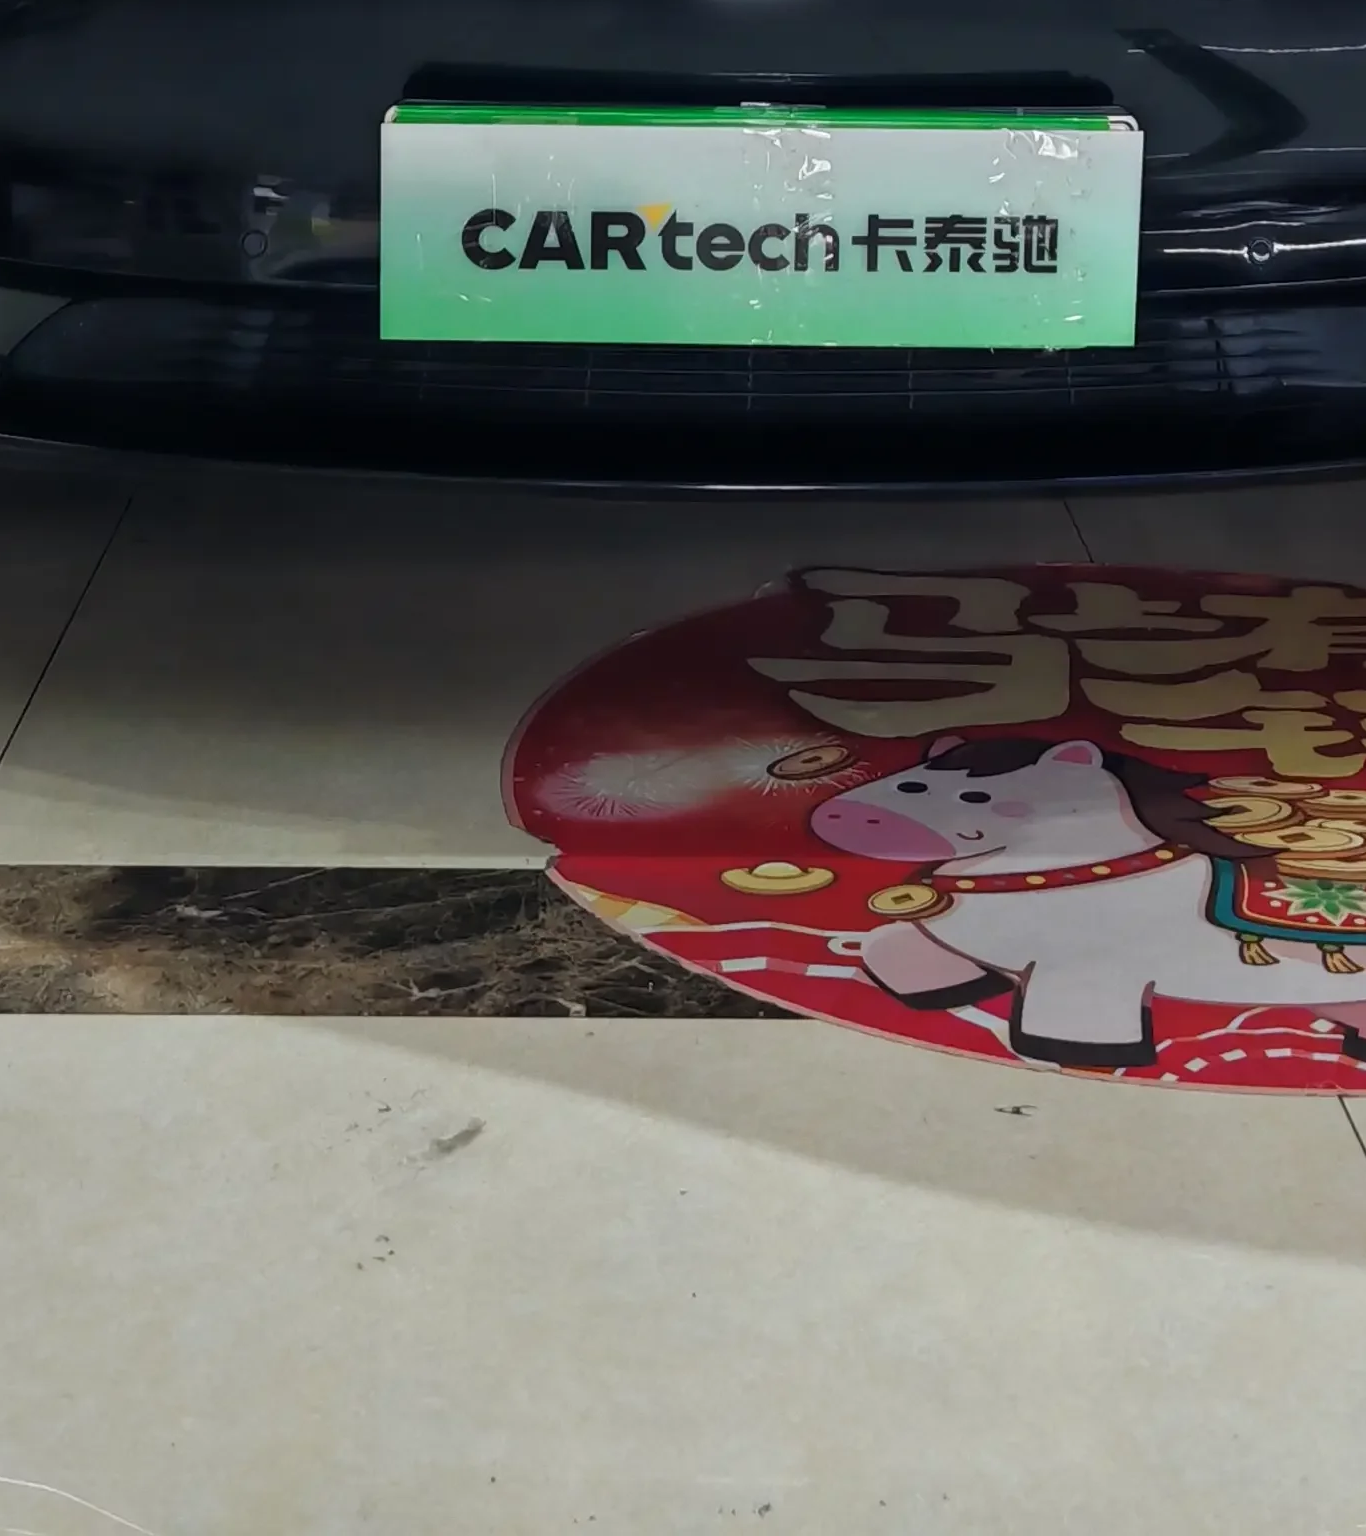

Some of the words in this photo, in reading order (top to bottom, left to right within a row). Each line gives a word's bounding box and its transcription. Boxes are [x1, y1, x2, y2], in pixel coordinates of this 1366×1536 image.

[461, 207, 841, 273] CARtech
[852, 213, 1059, 275] 卡泰驰
